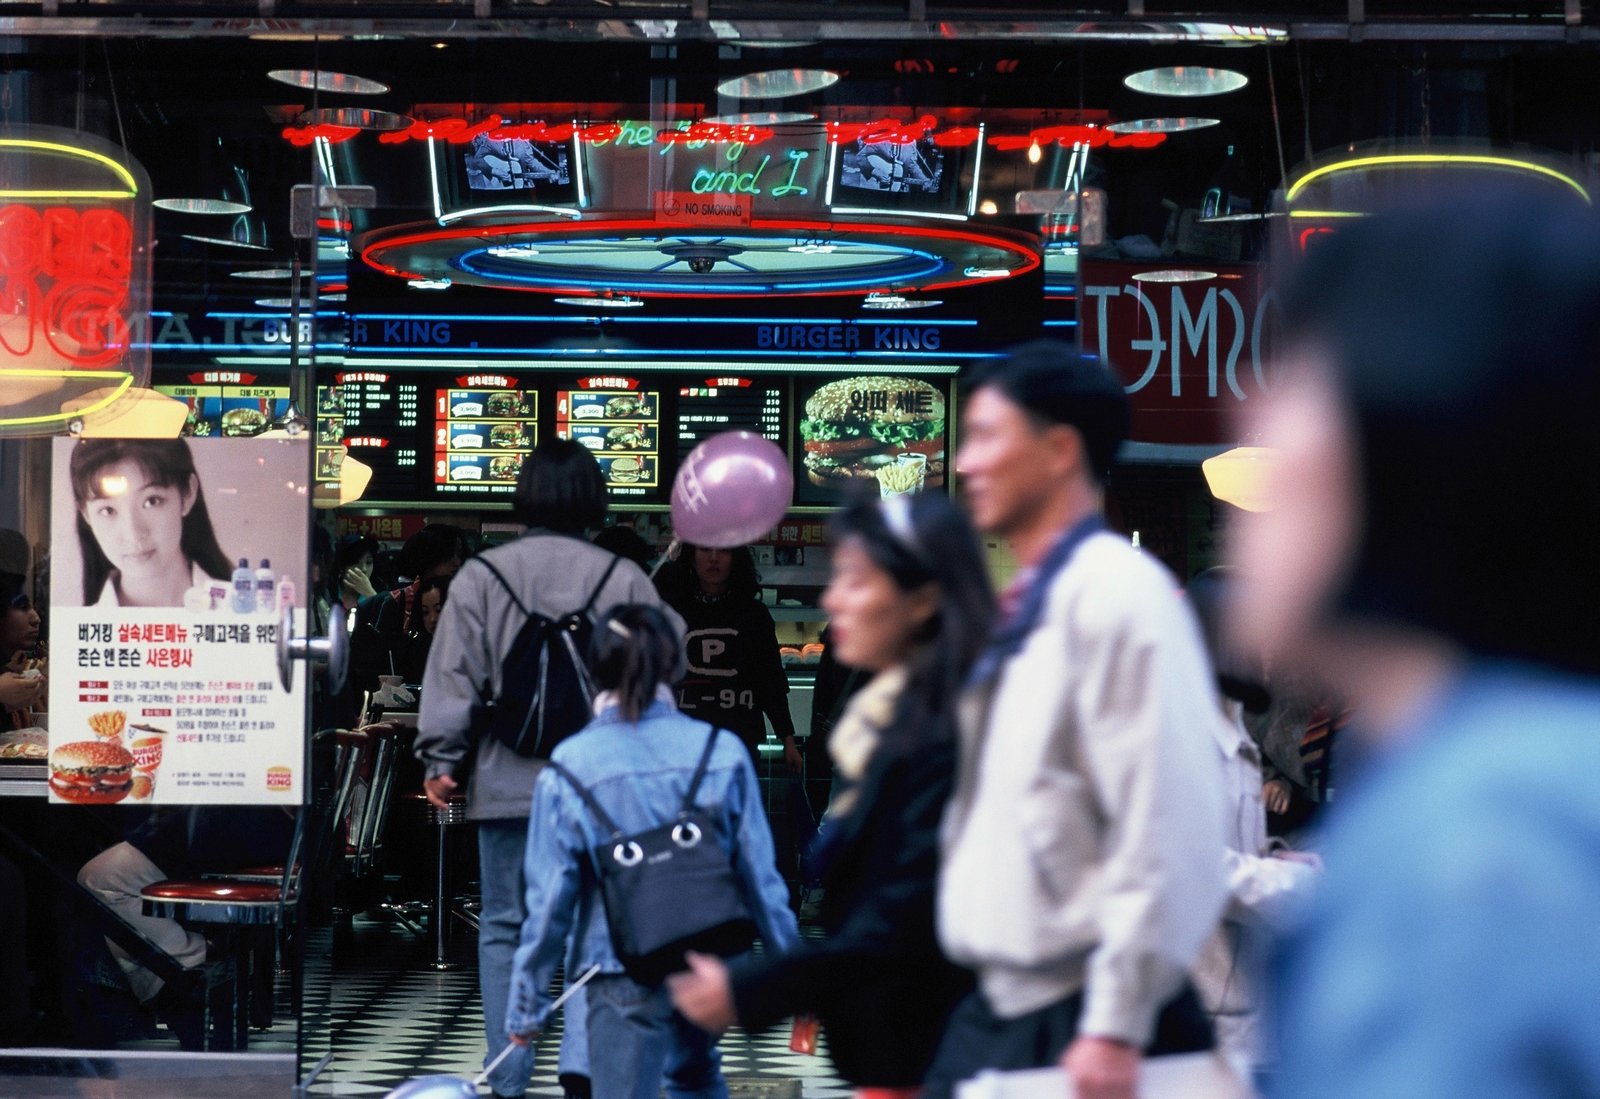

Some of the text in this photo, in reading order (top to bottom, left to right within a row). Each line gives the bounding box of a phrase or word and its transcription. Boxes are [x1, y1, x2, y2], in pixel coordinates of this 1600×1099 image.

[691, 154, 770, 194] and
[685, 203, 742, 217] NO SMOKING
[384, 321, 451, 344] KING
[757, 325, 941, 350] BURGER KING
[439, 397, 445, 413] 1
[558, 399, 567, 415] 4
[850, 390, 933, 414] 와퍼 세트
[437, 428, 447, 445] 2
[78, 623, 112, 643] 버거킹
[118, 623, 188, 643] 실속세트메뉴
[193, 623, 250, 644] 구매고객을
[78, 648, 193, 668] 존슨 앤 존슨 사은행사
[702, 639, 725, 663] P
